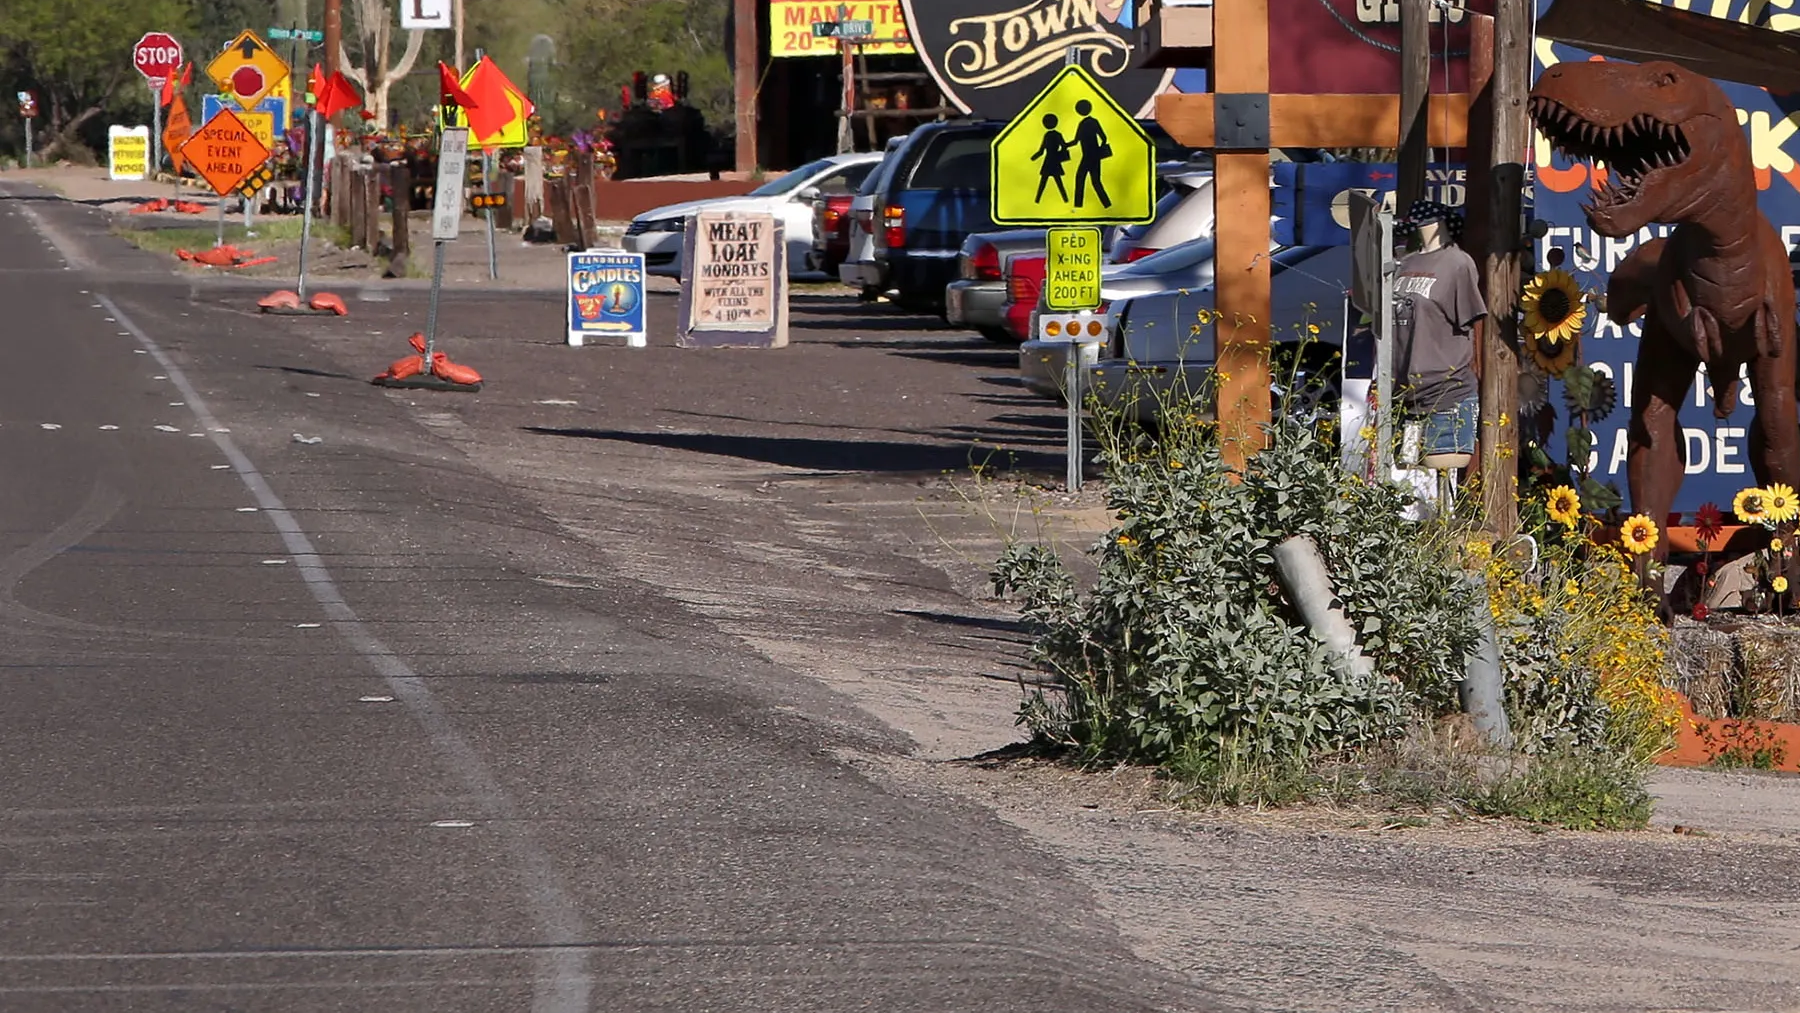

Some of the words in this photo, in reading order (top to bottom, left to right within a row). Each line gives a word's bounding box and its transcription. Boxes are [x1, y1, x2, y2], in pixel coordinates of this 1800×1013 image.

[785, 5, 857, 26] MANY
[868, 5, 904, 24] ITE
[138, 47, 177, 65] STOP
[244, 119, 262, 128] TOP
[203, 129, 247, 143] SPECIAL
[207, 146, 241, 158] EVENT
[206, 162, 243, 175] AHEAD
[1425, 169, 1467, 182] AVE
[708, 222, 762, 241] MEAT
[1061, 237, 1086, 248] PED
[710, 243, 760, 262] LOAF
[1057, 253, 1091, 265] X-ING
[701, 263, 768, 277] MONDAYS
[1054, 270, 1094, 282] AHEAD
[573, 269, 640, 292] CANDLES
[1054, 287, 1077, 299] 200
[1080, 287, 1093, 299] FT
